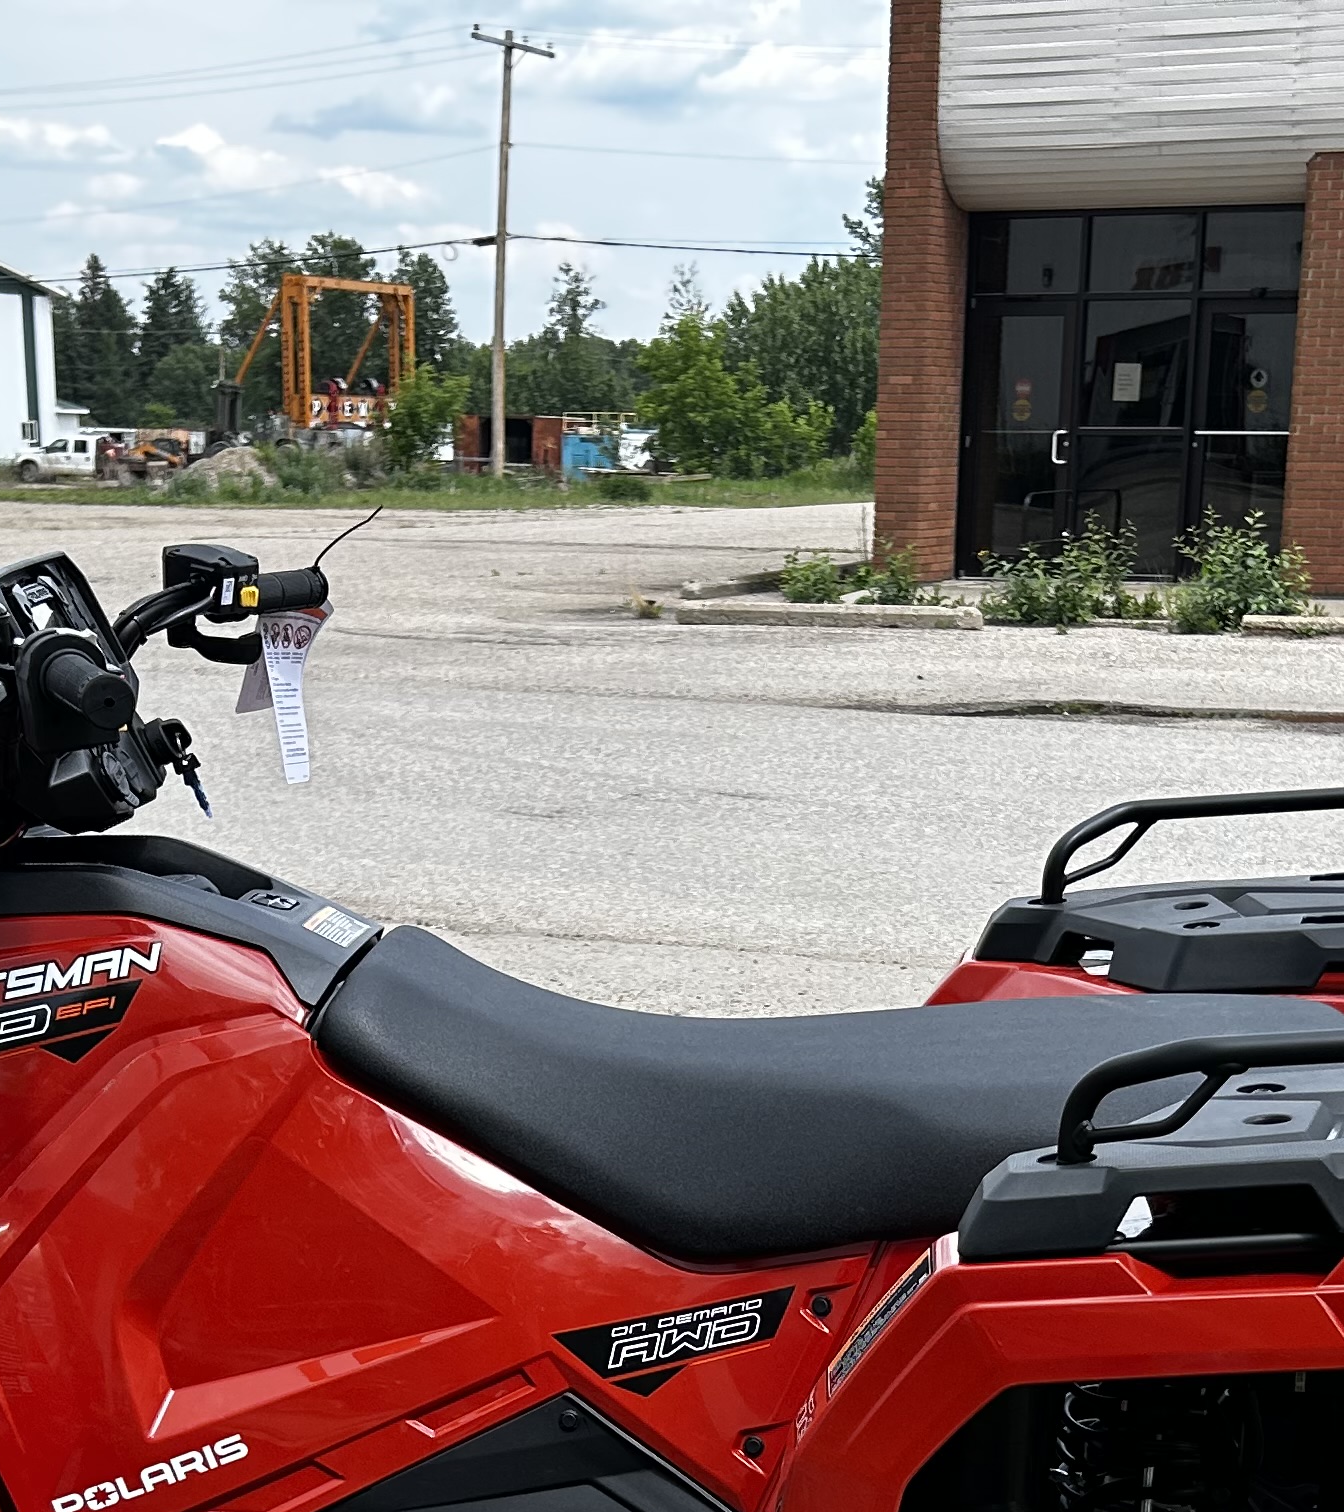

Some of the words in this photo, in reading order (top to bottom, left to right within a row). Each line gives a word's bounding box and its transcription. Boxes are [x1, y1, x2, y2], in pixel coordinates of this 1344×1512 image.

[56, 996, 115, 1021] EFI
[611, 1322, 647, 1337] ON
[657, 1298, 762, 1328] DEMAND
[607, 1312, 761, 1369] AWD
